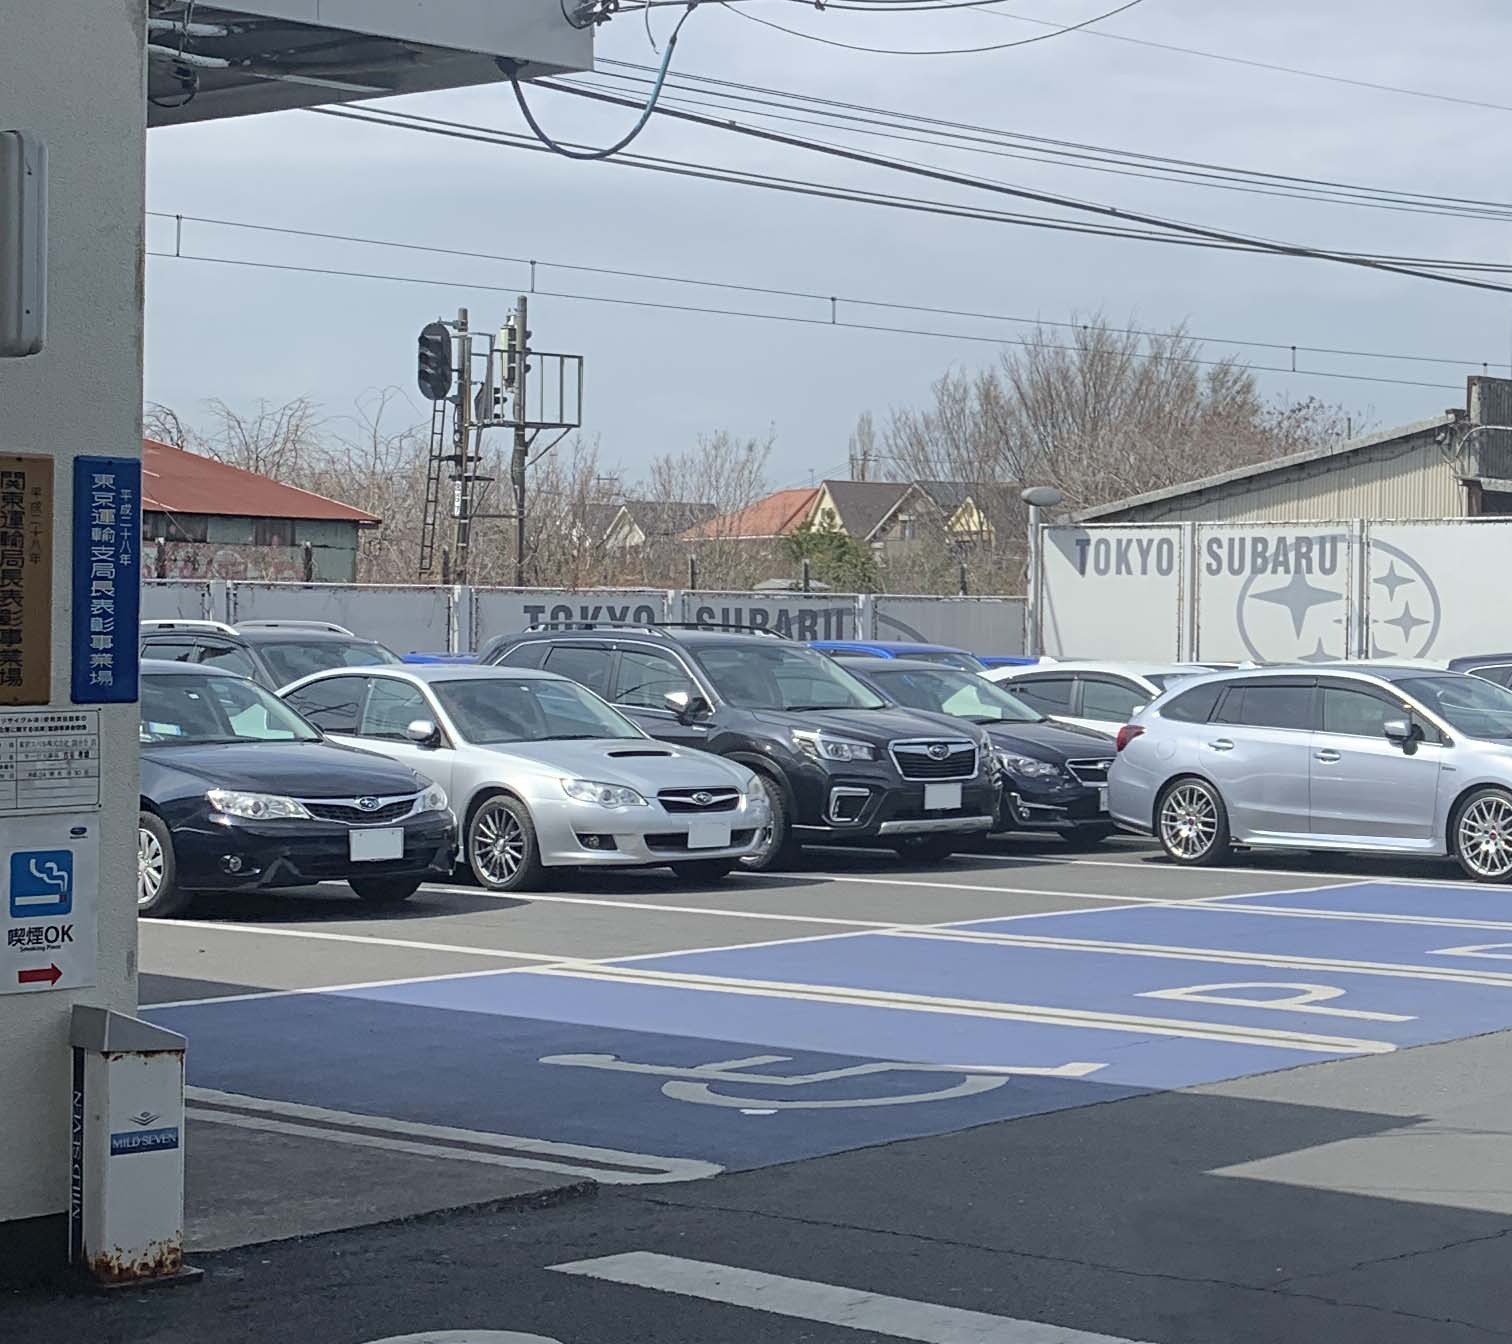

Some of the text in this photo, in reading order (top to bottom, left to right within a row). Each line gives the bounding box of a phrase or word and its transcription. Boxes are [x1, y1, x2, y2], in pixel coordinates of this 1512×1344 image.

[119, 488, 133, 566] 平成二十八年
[1075, 536, 1338, 577] TOKYO SUBARU
[89, 472, 117, 687] 東京運輸支局長表彰事業場
[7, 924, 74, 947] 喫煙OK
[112, 1133, 177, 1149] MILD SEVEN
